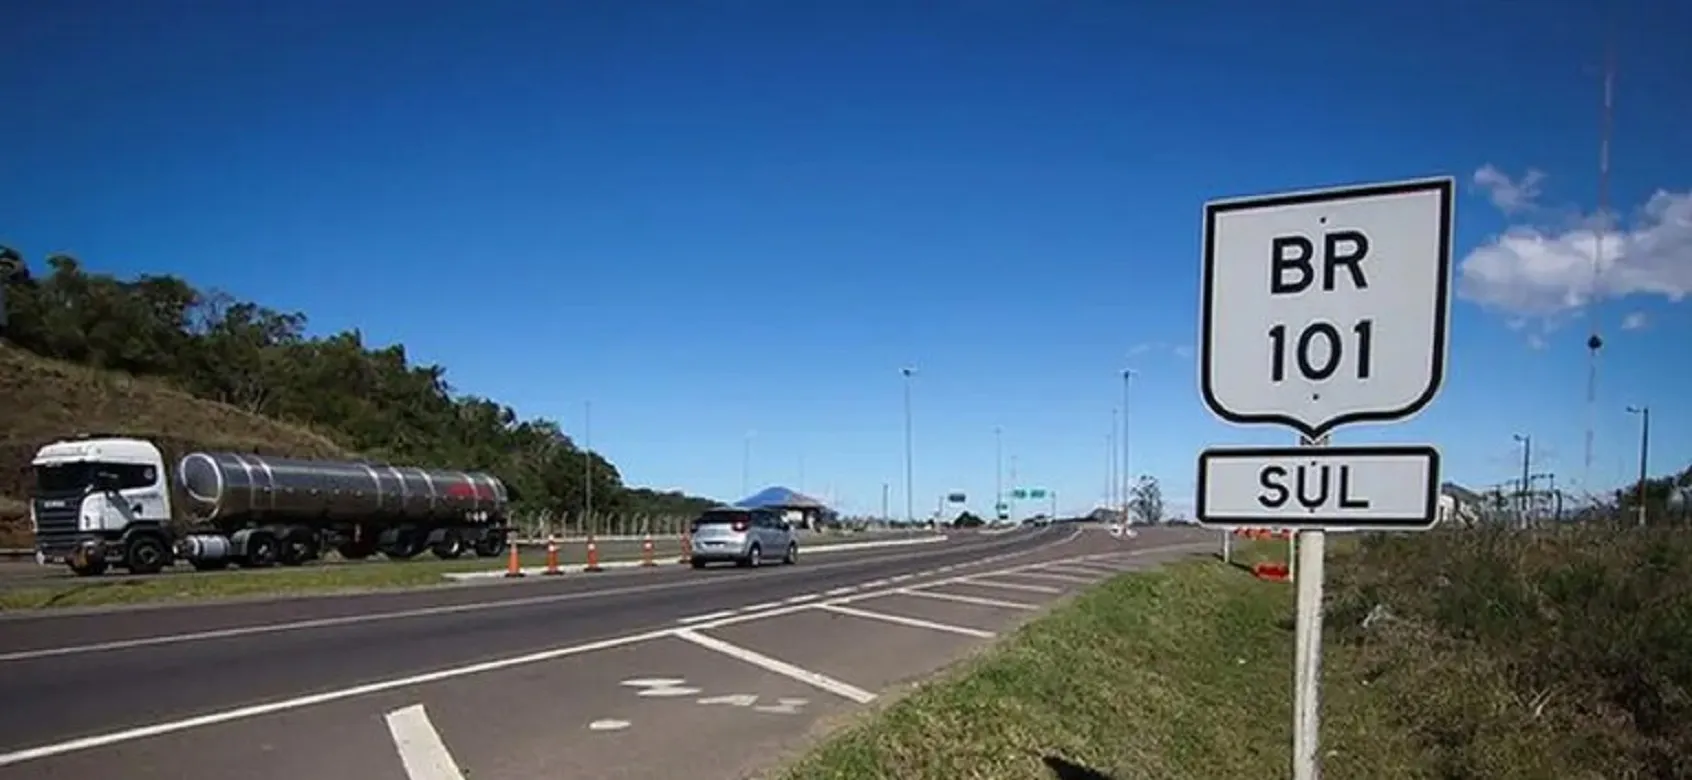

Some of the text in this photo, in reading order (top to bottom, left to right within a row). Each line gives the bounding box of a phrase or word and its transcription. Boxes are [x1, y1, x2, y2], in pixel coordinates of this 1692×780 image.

[1270, 230, 1369, 294] BR
[1268, 319, 1372, 381] 101
[1258, 465, 1370, 509] SUL
